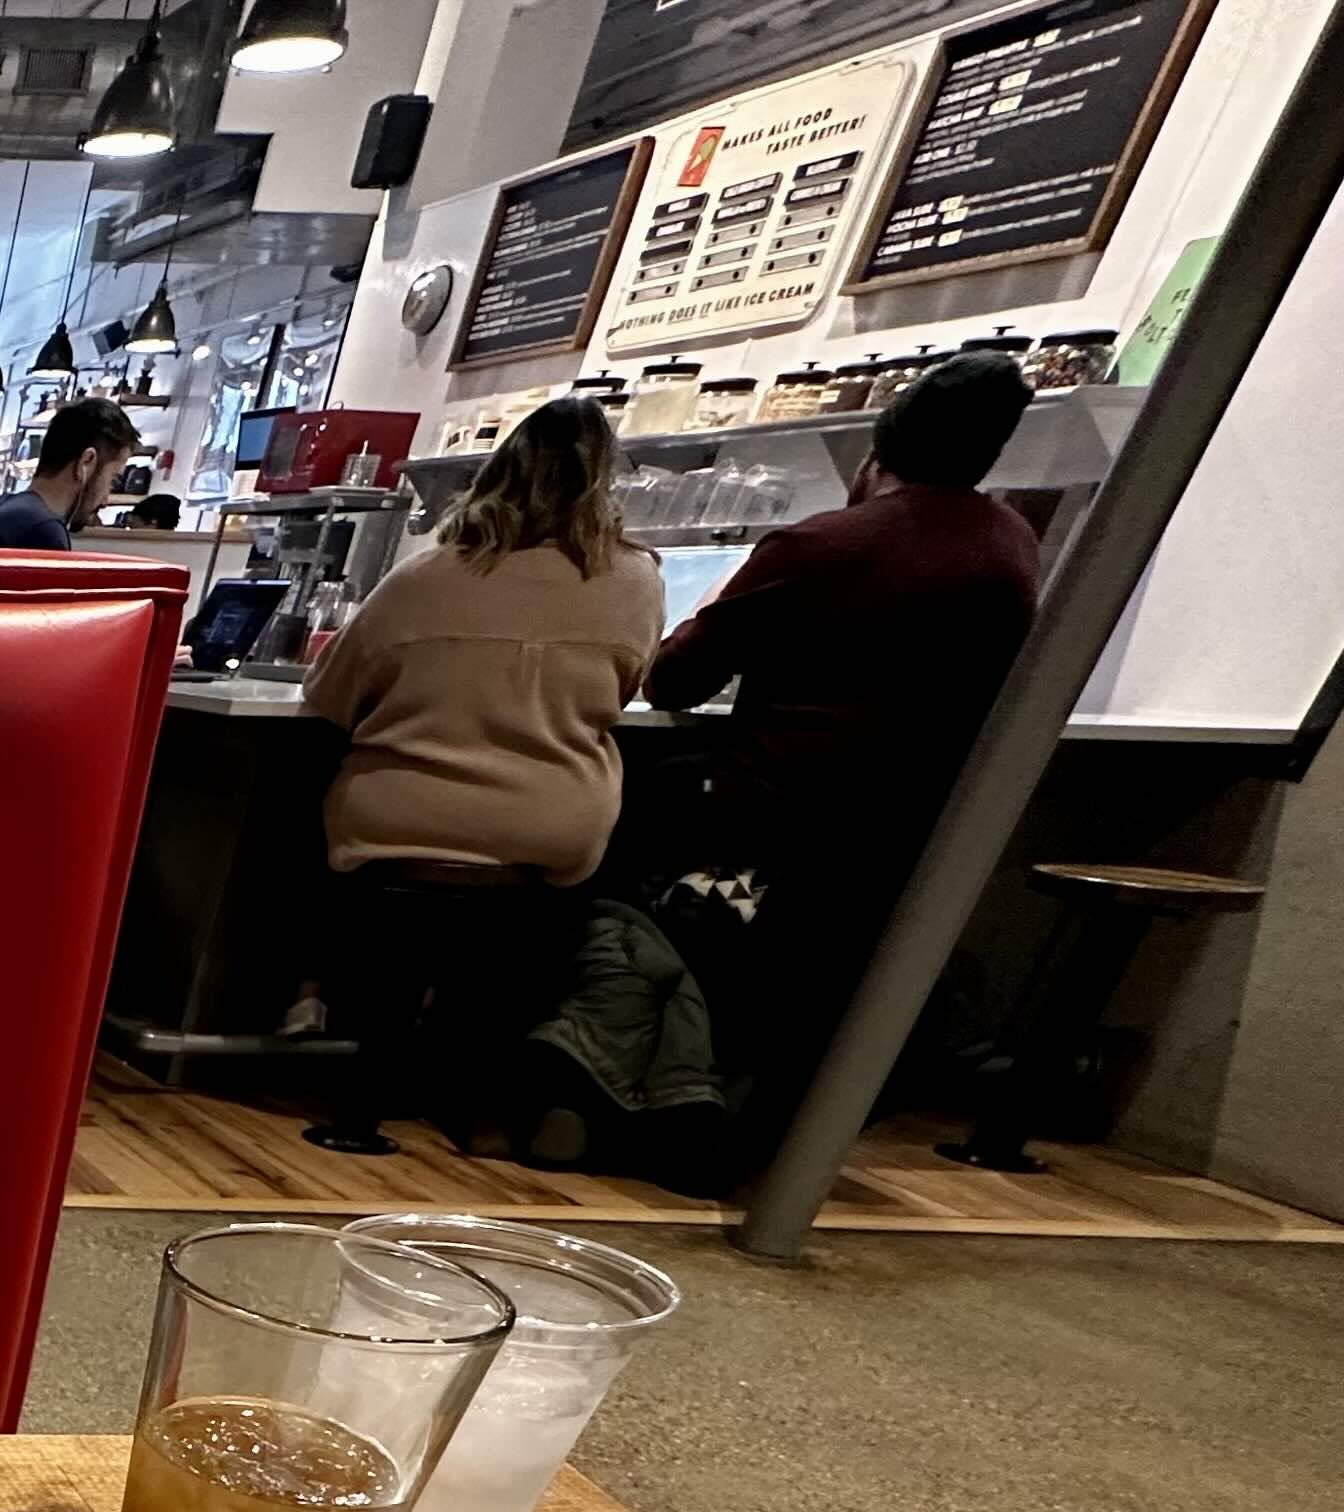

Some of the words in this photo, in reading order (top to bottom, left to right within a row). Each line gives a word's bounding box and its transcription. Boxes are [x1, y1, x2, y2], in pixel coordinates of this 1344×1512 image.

[722, 128, 764, 151] MAKES
[767, 120, 790, 137] ALL
[794, 107, 833, 129] FOOD
[766, 134, 805, 155] TASTE
[809, 114, 868, 142] BETTER!
[619, 314, 665, 330] NOTHING
[669, 304, 698, 322] DOES
[700, 302, 712, 315] IT
[715, 295, 742, 311] LIKE
[744, 291, 764, 307] ICE
[768, 282, 816, 302] CREAM
